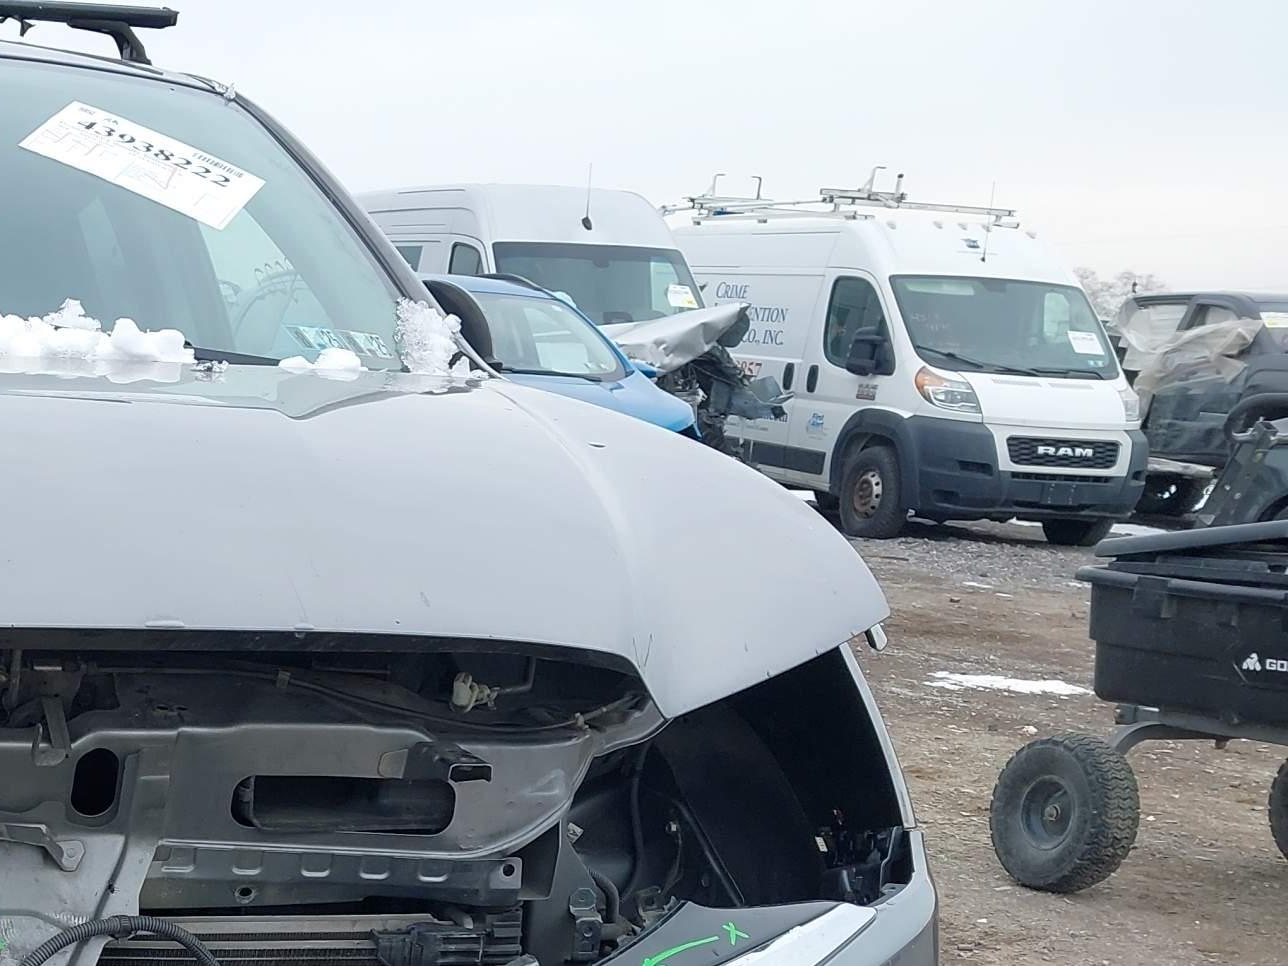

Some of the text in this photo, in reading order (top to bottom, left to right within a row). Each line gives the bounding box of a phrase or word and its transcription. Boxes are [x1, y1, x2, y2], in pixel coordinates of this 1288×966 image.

[76, 119, 231, 188] 43938222
[715, 281, 750, 299] CRIME
[1037, 445, 1094, 458] RAM
[1265, 658, 1288, 672] GO
